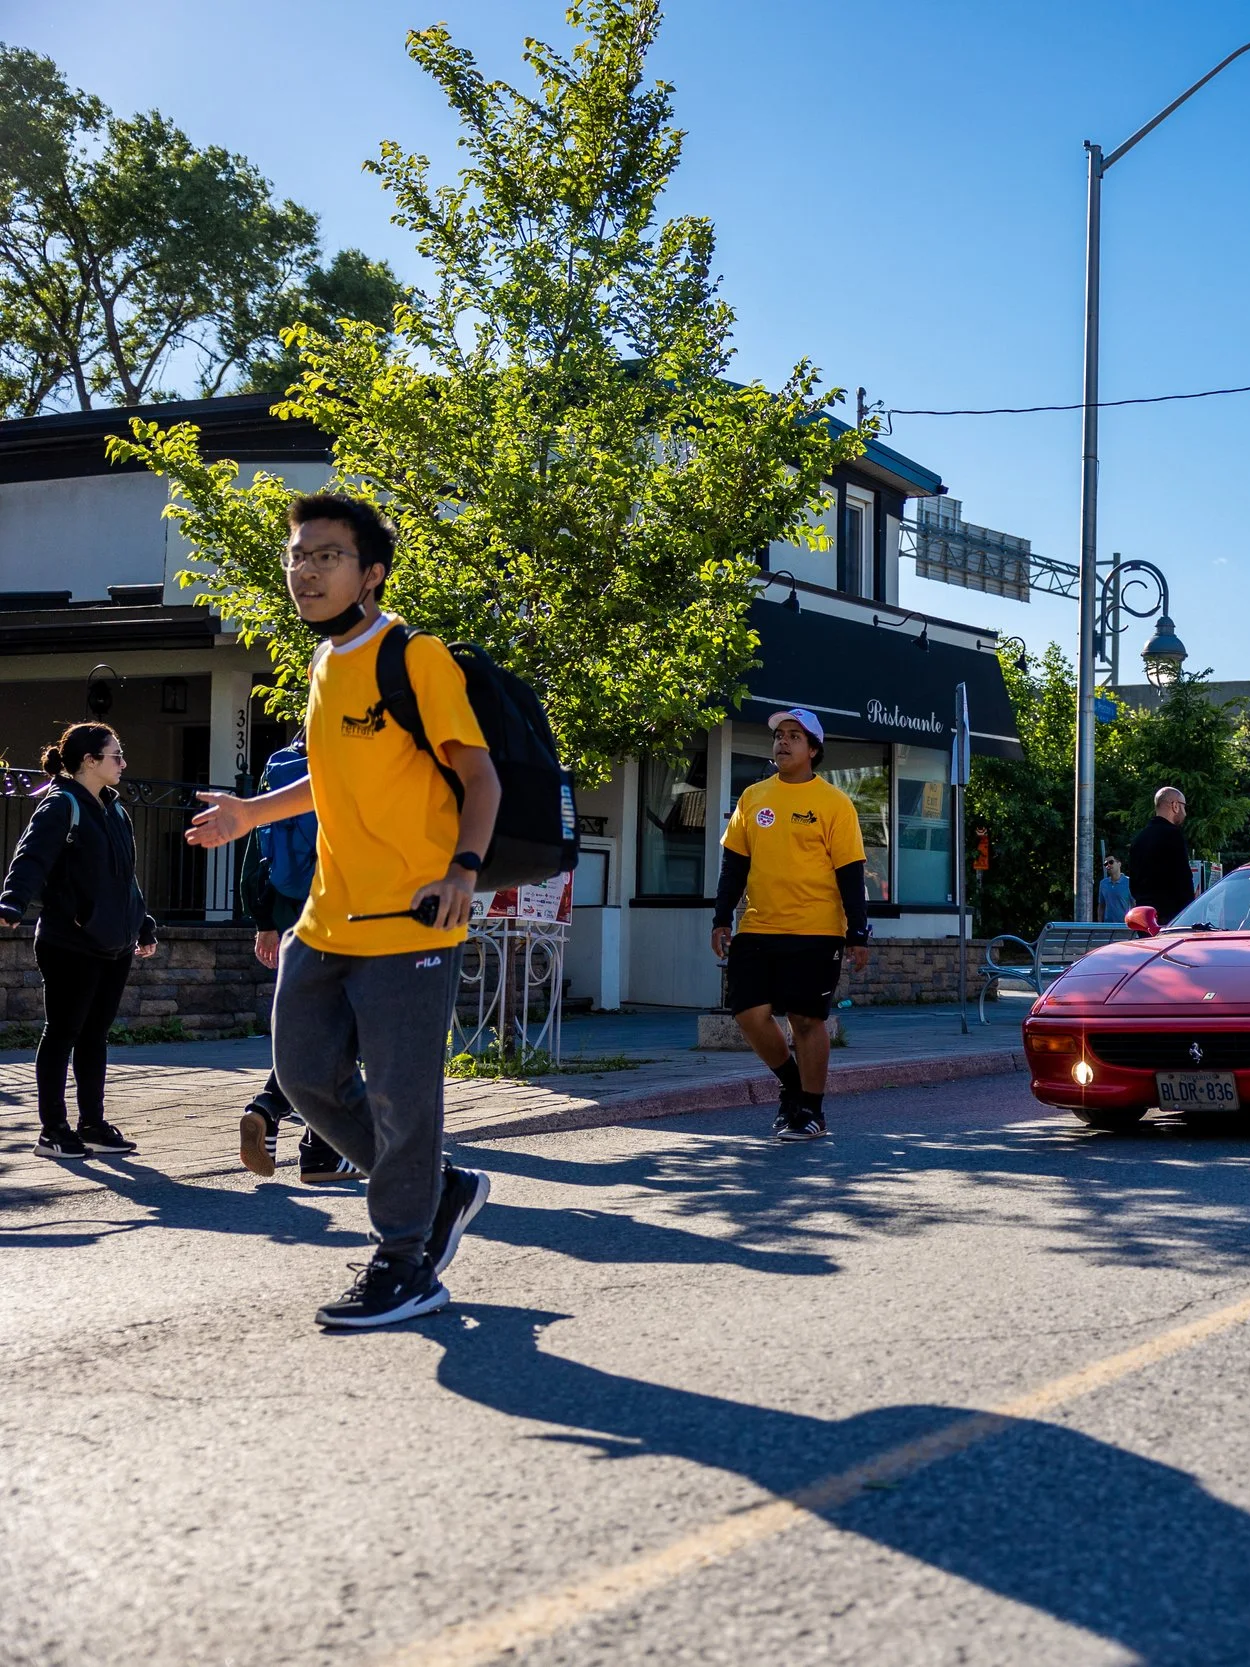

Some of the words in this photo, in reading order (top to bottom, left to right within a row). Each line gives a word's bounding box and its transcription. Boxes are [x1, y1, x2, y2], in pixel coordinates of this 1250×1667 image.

[866, 699, 944, 734] Ristorante
[416, 956, 442, 969] FILA
[1206, 1082, 1235, 1101] 836
